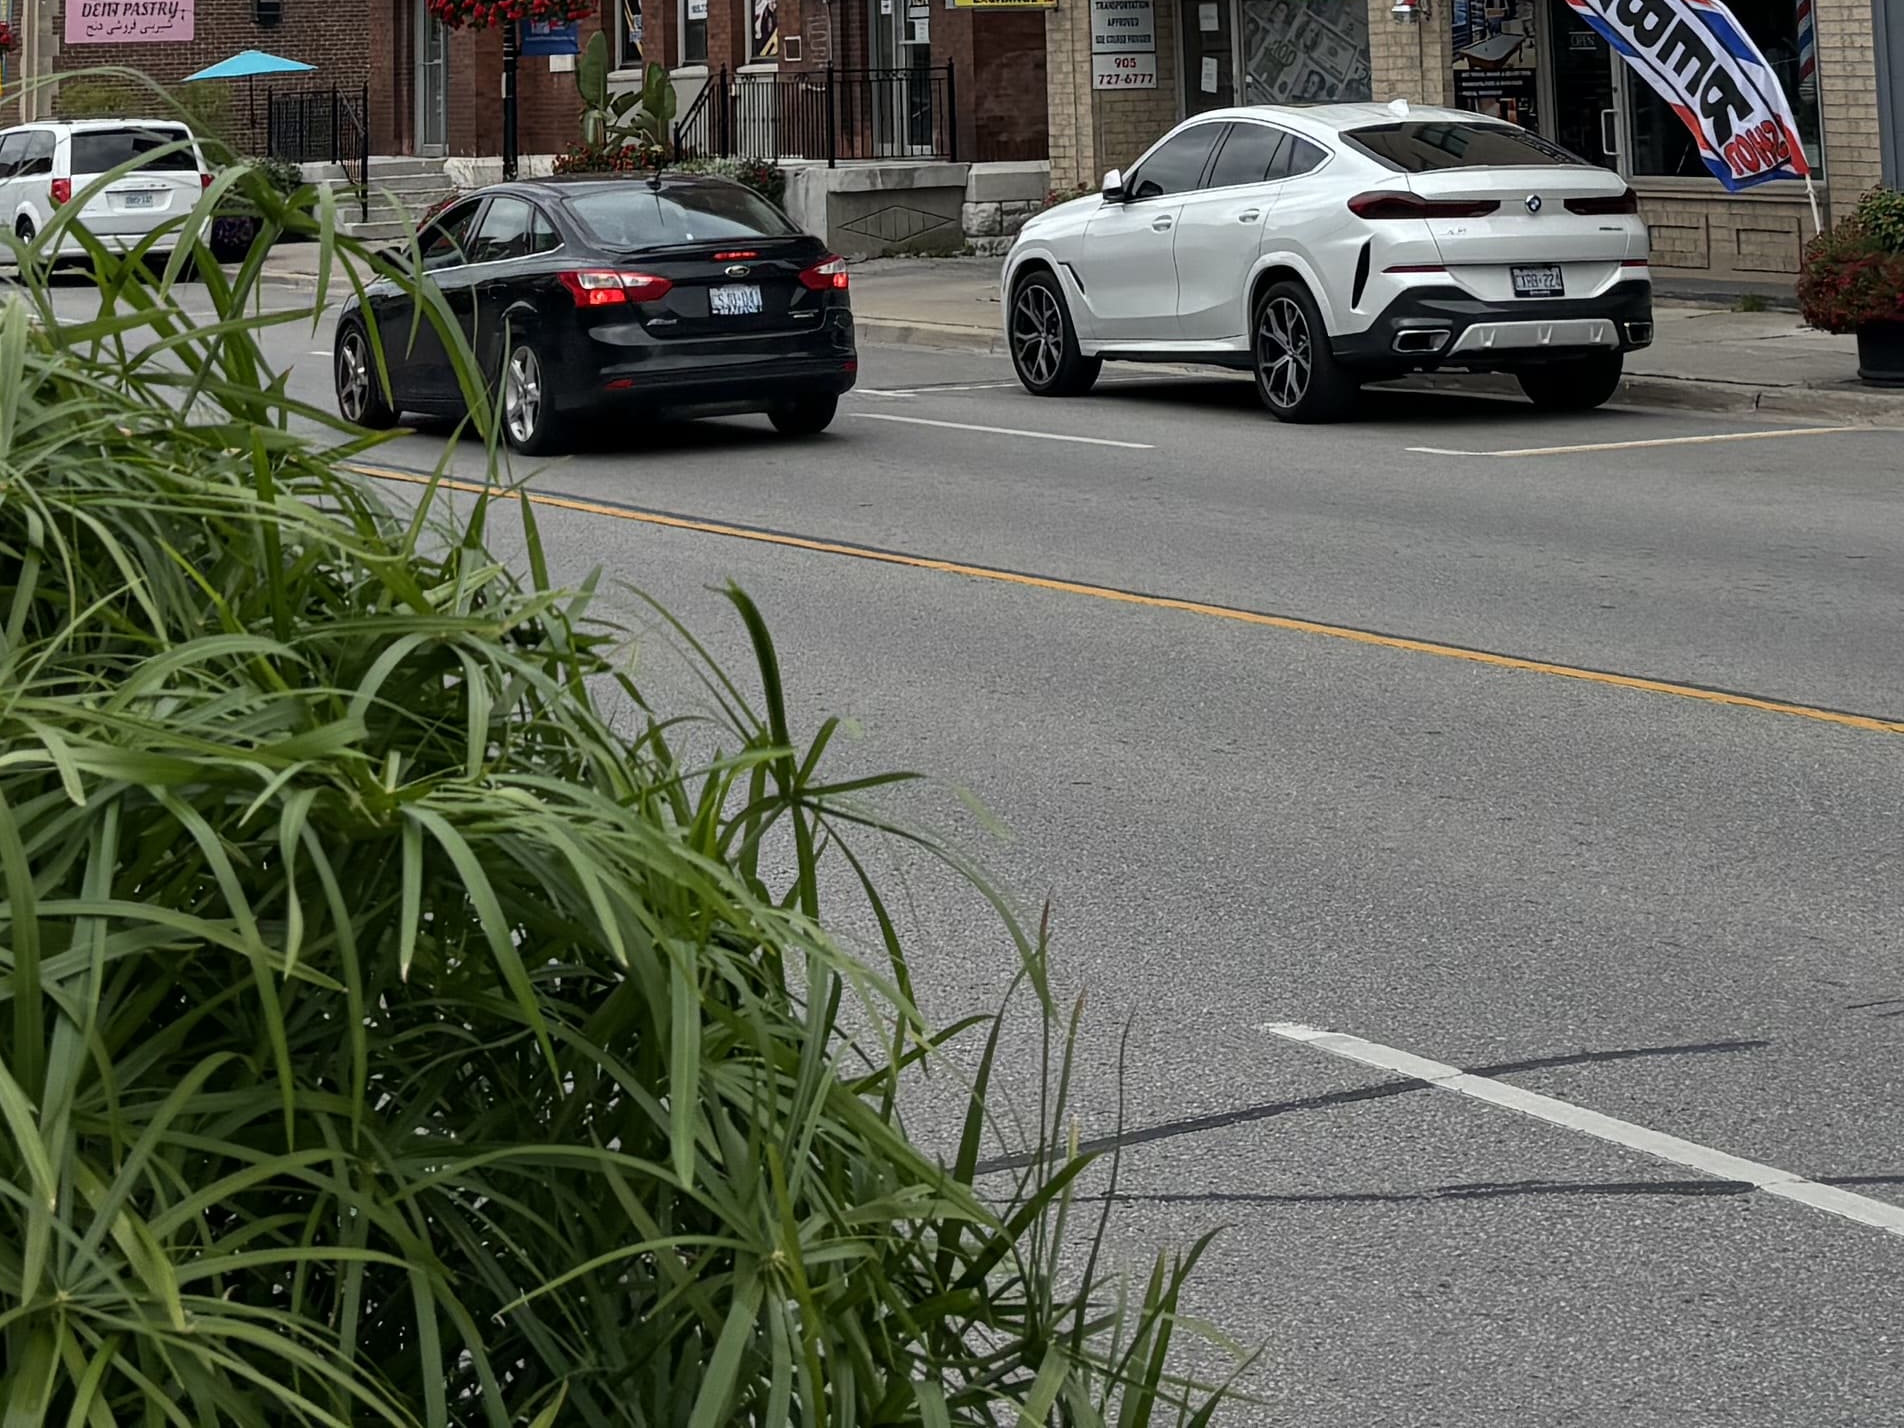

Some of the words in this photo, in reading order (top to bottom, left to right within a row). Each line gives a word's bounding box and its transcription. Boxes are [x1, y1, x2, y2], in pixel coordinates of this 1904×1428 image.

[122, 0, 179, 19] PASTRY
[1114, 57, 1137, 69] 905
[1098, 73, 1154, 85] 727-6777
